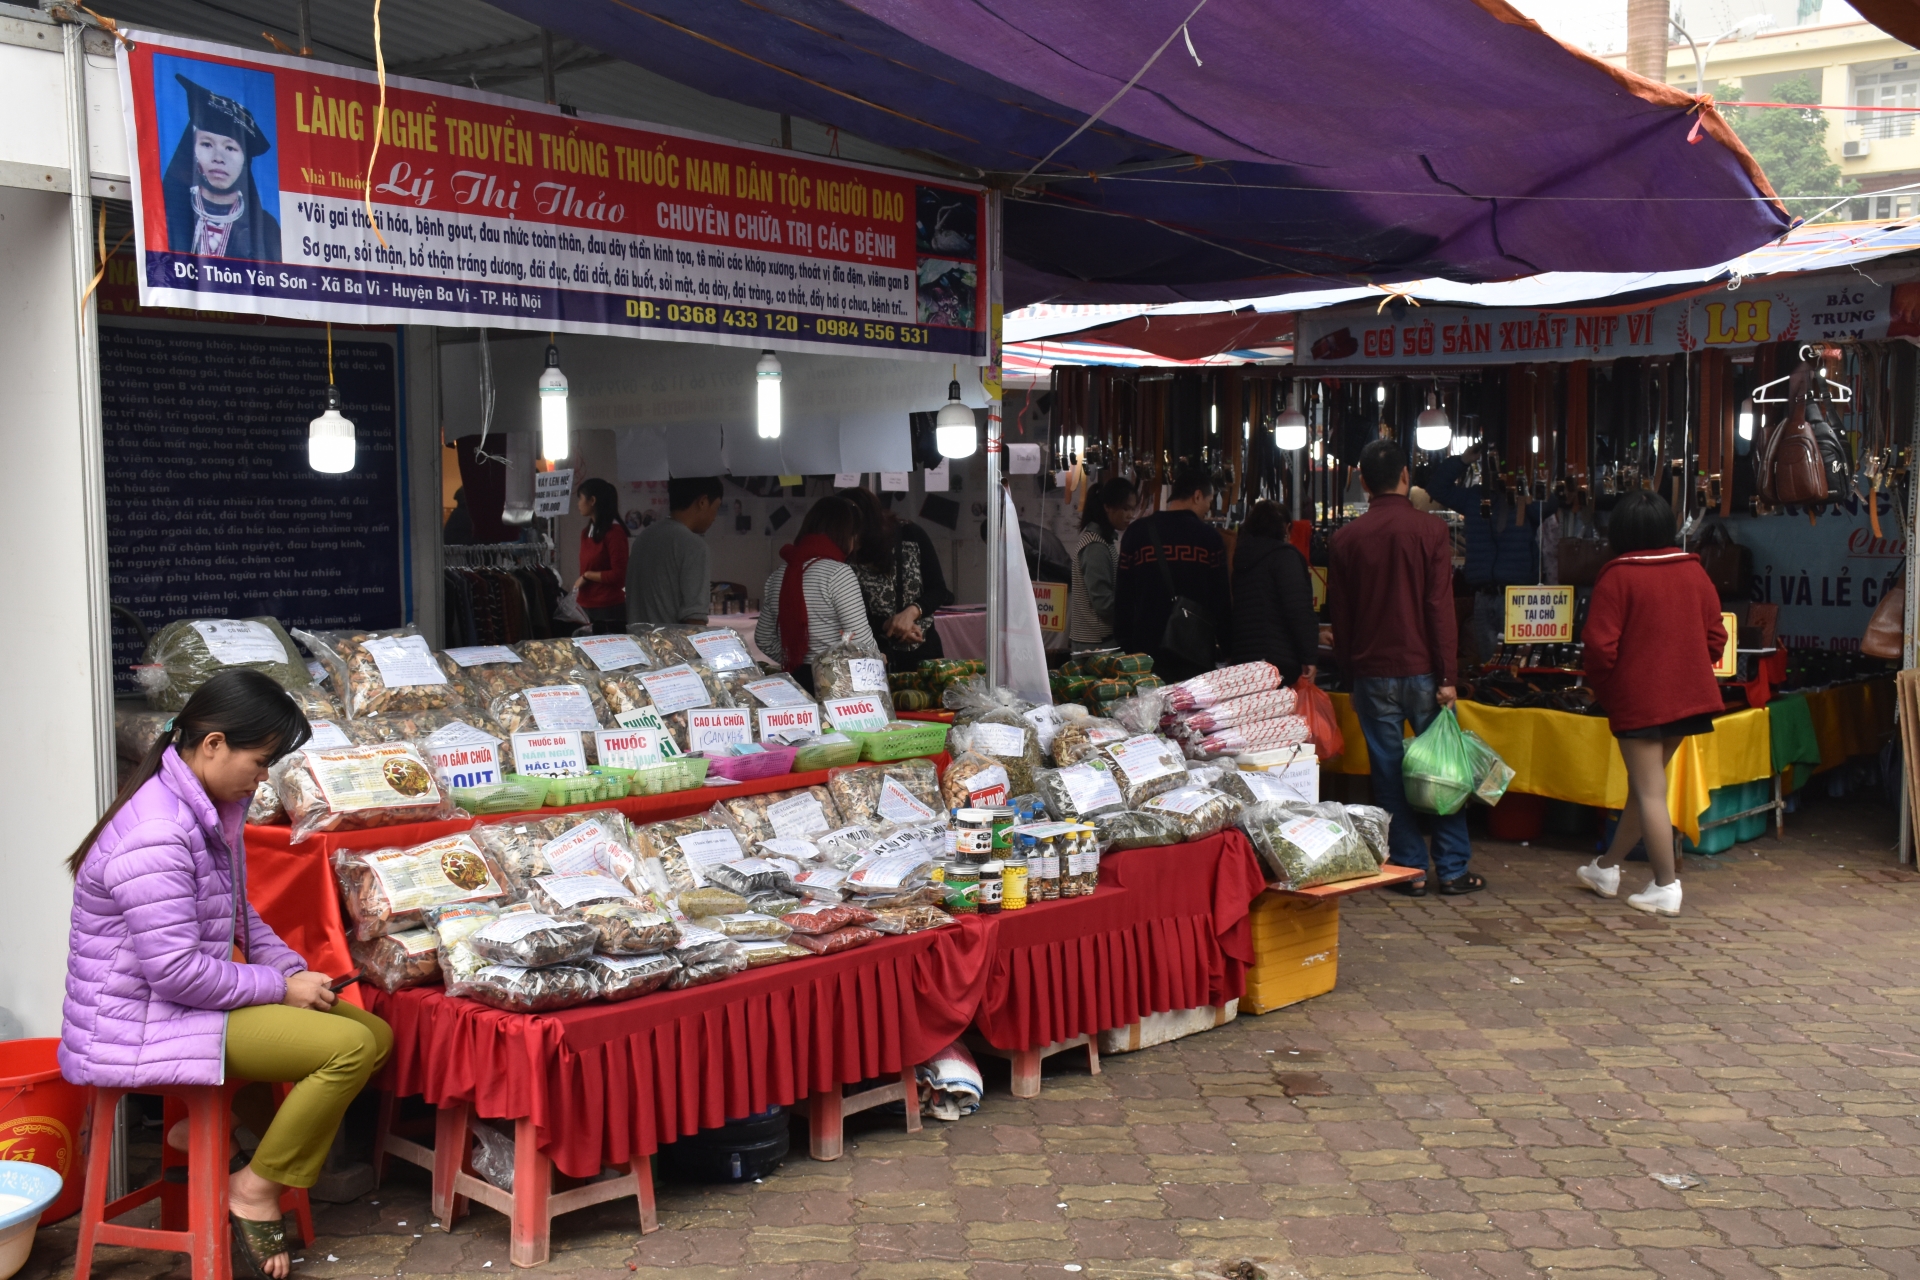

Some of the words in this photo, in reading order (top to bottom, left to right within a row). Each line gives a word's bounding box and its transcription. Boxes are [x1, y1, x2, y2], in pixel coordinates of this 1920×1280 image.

[295, 86, 364, 141] LÀNG
[372, 101, 438, 153] NGHỀ
[444, 114, 533, 167] TRUYỀN
[539, 126, 609, 178] THỐNG
[614, 140, 679, 189] THUỐC
[686, 157, 730, 196] NAM
[736, 161, 773, 203] DÂN
[778, 167, 811, 214] TỘC
[816, 176, 867, 217] NGƯỜI
[872, 188, 904, 223] DAO
[300, 167, 326, 186] Nhà
[375, 161, 438, 206] Lý
[450, 170, 521, 220] Thị
[533, 181, 628, 223] Thảo
[656, 203, 730, 237] CHUYÊN
[735, 210, 782, 244] CHỮA
[786, 220, 812, 253] TRỊ
[817, 222, 850, 253] CÁC
[854, 227, 896, 261] BỆNH
[329, 206, 349, 230] gai
[352, 208, 384, 230] thoái
[386, 211, 412, 236] hóa,
[416, 215, 444, 241] bệnh
[447, 223, 476, 243] gout,
[479, 221, 500, 243] đau
[503, 226, 529, 246] nhức
[531, 229, 556, 249] toàn
[558, 232, 585, 255] thân,
[587, 234, 607, 255] đau
[608, 238, 626, 261] dây
[629, 238, 651, 260] thần
[653, 243, 674, 262] kinh
[675, 248, 695, 269] tọa,
[696, 249, 706, 266] tê
[708, 249, 725, 269] mỏi
[727, 252, 743, 271] các
[744, 254, 767, 277] khớp
[768, 262, 798, 280] xương,
[799, 262, 821, 281] thoát
[822, 265, 831, 285] vị
[832, 264, 845, 283] đĩa
[846, 266, 866, 289] đệm,
[867, 271, 887, 289] viêm
[888, 275, 902, 292] gan
[903, 274, 909, 291] B
[174, 261, 199, 281] ĐC:
[203, 265, 242, 284] Thôn
[246, 267, 276, 288] Yên
[279, 271, 308, 291] Sơn
[321, 273, 341, 293] Xã
[344, 276, 363, 294] Ba
[366, 276, 380, 295] Vì
[392, 281, 434, 304] Huyện
[436, 285, 453, 302] Ba
[456, 286, 470, 304] Vì
[480, 289, 499, 306] TP.
[502, 290, 518, 307] Hà
[521, 292, 541, 310] Nội
[302, 236, 321, 257] Sơ
[324, 242, 351, 263] gan,
[354, 239, 372, 262] sỏi
[375, 244, 406, 270] thận,
[409, 243, 424, 267] bổ
[427, 249, 454, 275] thận
[456, 252, 487, 277] tráng
[490, 255, 527, 281] dương,
[529, 258, 546, 279] đái
[548, 260, 570, 286] đục,
[572, 263, 589, 283] đái
[591, 261, 612, 288] dắt,
[614, 267, 629, 287] đái
[631, 268, 657, 292] buốt,
[659, 271, 673, 292] sỏi
[674, 275, 696, 299] mật,
[698, 277, 710, 301] dạ
[712, 278, 731, 302] dày,
[732, 280, 746, 304] đại
[748, 283, 774, 305] tràng,
[775, 289, 787, 302] co
[788, 284, 808, 308] thắt,
[809, 287, 825, 311] đầy
[826, 292, 840, 310] hơi
[848, 295, 870, 314] chua,
[871, 297, 890, 318] bệnh
[1826, 288, 1865, 307] BẮC
[625, 299, 661, 321] DĐ:
[666, 303, 717, 326] 0368
[722, 309, 758, 329] 433
[764, 313, 799, 332] 120
[816, 318, 860, 338] 0984
[864, 323, 895, 341] 556
[900, 327, 928, 344] 531
[1704, 299, 1772, 345] LH
[1811, 309, 1876, 325] TRUNG
[1362, 325, 1396, 359] CƠ
[1401, 318, 1434, 358] SỞ
[1441, 315, 1491, 356] SẢN
[1498, 311, 1568, 353] XUẤT
[1573, 314, 1619, 355] NỊT
[1625, 306, 1656, 347] VÍ
[1822, 329, 1865, 341] NAM
[1780, 569, 1813, 606] VÀ
[1821, 566, 1852, 607] LẺ
[1512, 595, 1526, 608] NỊT
[1527, 595, 1538, 605] DA
[1540, 592, 1551, 605] BÒ
[1525, 609, 1537, 622] TẠI
[1510, 623, 1557, 637] 150.000
[1560, 623, 1568, 637] đ
[766, 709, 795, 727] THUỐC
[797, 710, 813, 727] BỘT
[835, 700, 875, 717] THUỐC
[693, 716, 710, 728] CAO
[711, 714, 722, 728] LÁ
[723, 713, 745, 727] CHỮA
[527, 736, 552, 748] THUỐC
[553, 736, 566, 746] BÔI
[604, 732, 648, 751] THUỐC
[432, 754, 448, 768] CAO
[449, 748, 469, 767] GẮM
[470, 746, 493, 764] CHỮA
[525, 760, 551, 771] HẮC
[554, 759, 577, 769] LÀO
[550, 842, 573, 859] THUỐC
[273, 1232, 284, 1242] VIP
